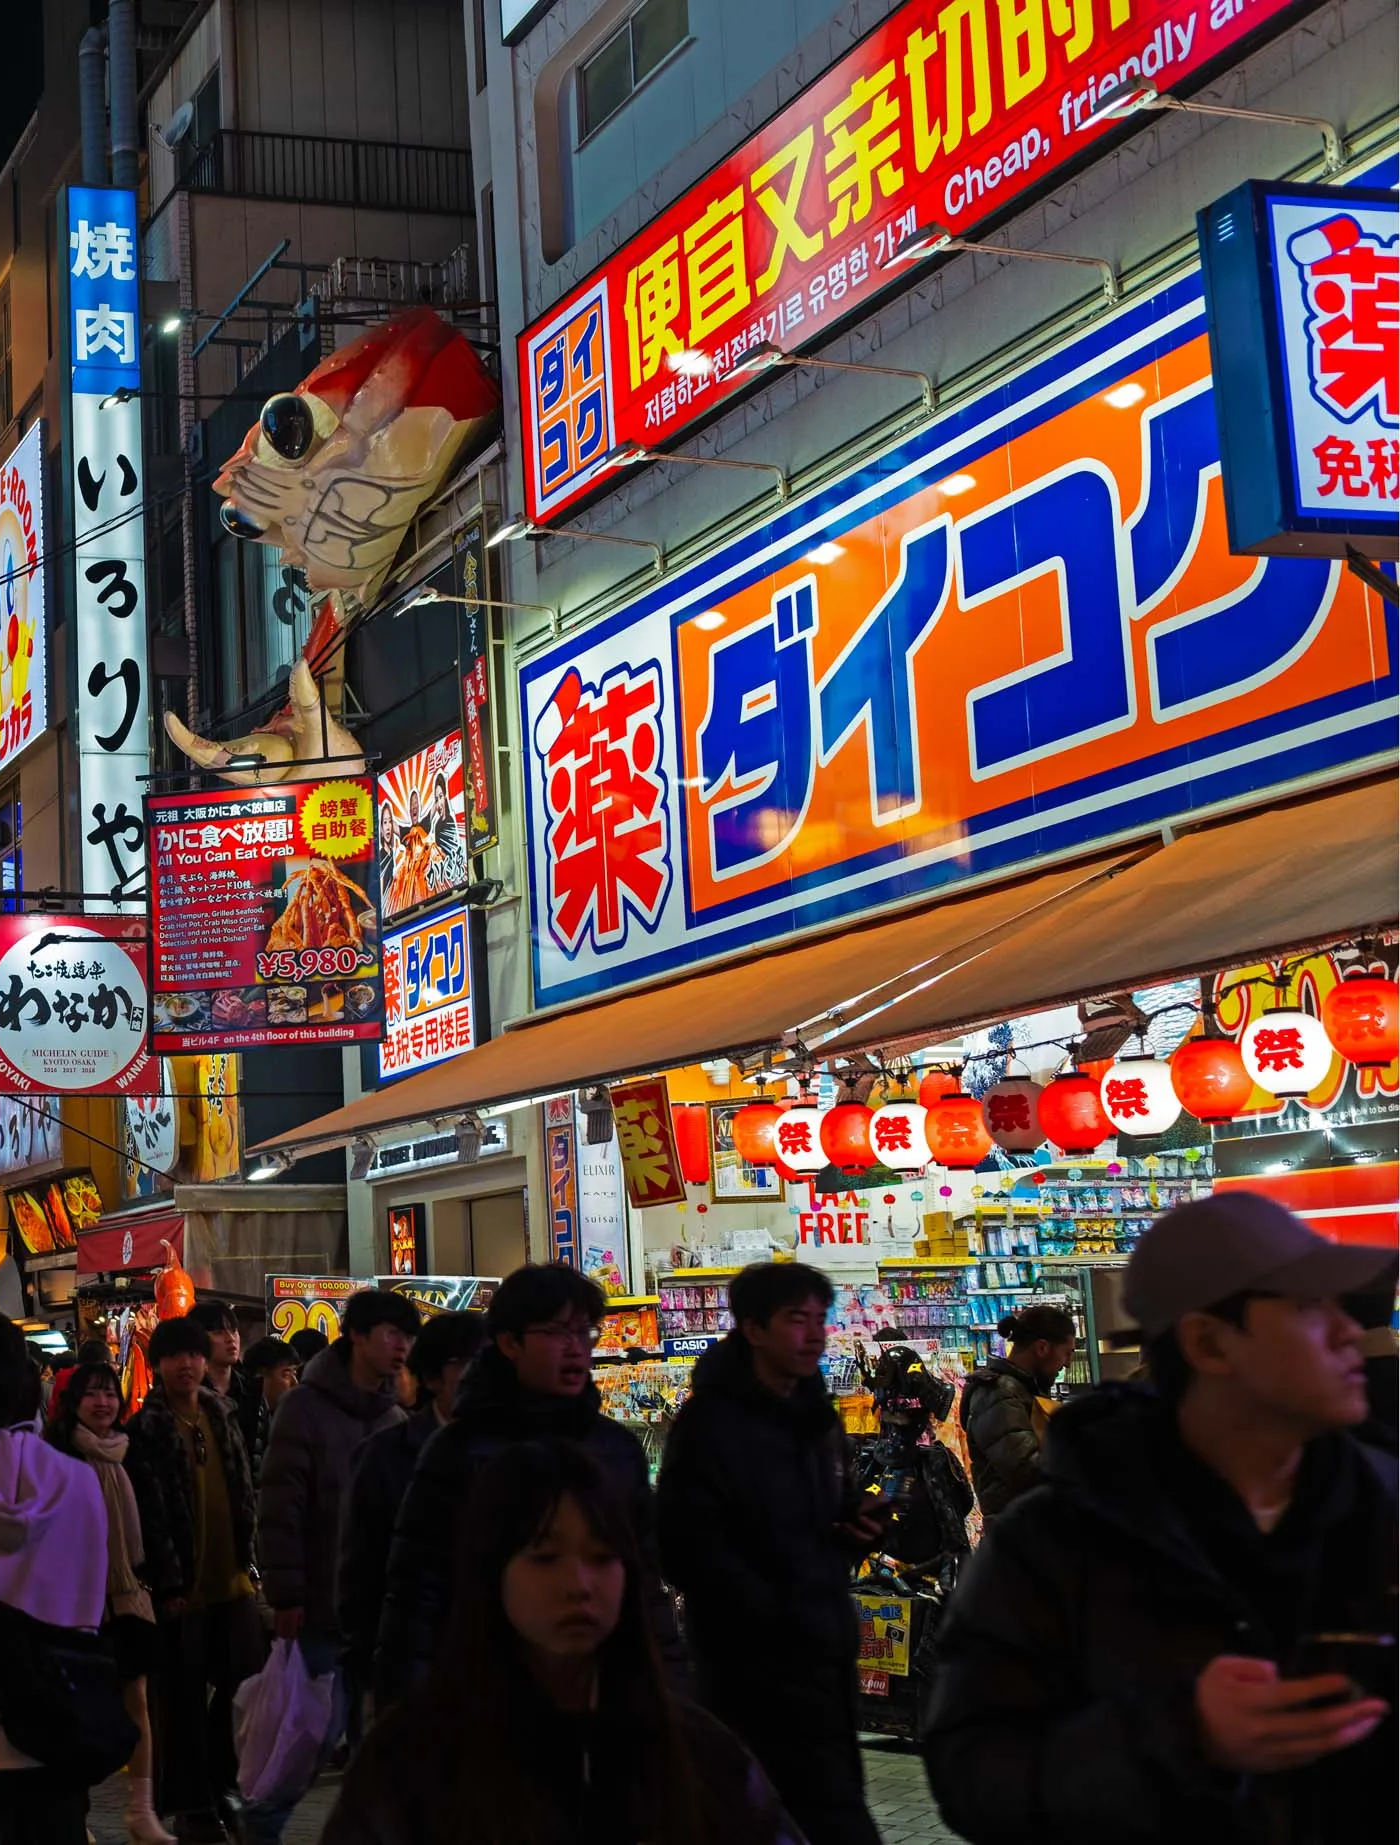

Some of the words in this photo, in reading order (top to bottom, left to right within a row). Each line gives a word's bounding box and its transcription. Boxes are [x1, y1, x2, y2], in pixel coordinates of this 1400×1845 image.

[944, 127, 1051, 216] Cheap,
[1059, 13, 1196, 136] friendly
[624, 0, 1130, 391] 便宜又亲切的
[808, 241, 869, 315] 유명한
[873, 205, 917, 265] 가게
[70, 221, 135, 365] 焼肉
[11, 466, 37, 582] ROOM
[701, 391, 1340, 872] ダイコク
[77, 453, 144, 888] いろりや
[156, 811, 178, 822] 元祖
[184, 800, 287, 820] 大阪かに食べ放題店
[320, 797, 358, 818] 螃蟹
[158, 819, 293, 851] かに食べ放題!
[311, 819, 367, 840] 自助餐
[158, 854, 172, 867] All
[177, 853, 201, 865] You
[205, 851, 231, 862] Can
[236, 848, 257, 860] Eat
[261, 845, 294, 856] Crab
[407, 923, 465, 1010] ダイコク
[80, 1049, 110, 1057] GUIDE
[236, 1033, 249, 1042] the
[251, 1032, 264, 1042] 4th
[266, 1031, 287, 1040] floor
[288, 1030, 299, 1039] of
[300, 1029, 316, 1039] this
[317, 1028, 354, 1039] building
[383, 1006, 470, 1069] 免税专用楼层
[1253, 1028, 1304, 1072] 祭
[116, 1047, 151, 1089] WANAK
[1106, 1078, 1149, 1119] 祭
[616, 1099, 672, 1195] 薬
[778, 1122, 813, 1153] 祭
[875, 1116, 913, 1152] 祭
[583, 1164, 615, 1176] ELIXIR
[584, 1214, 619, 1224] suisai
[799, 1213, 870, 1244] FREE
[280, 1281, 295, 1290] Buy
[319, 1282, 350, 1290] 100,000
[274, 1300, 342, 1344] 20
[673, 1340, 708, 1350] CASIO
